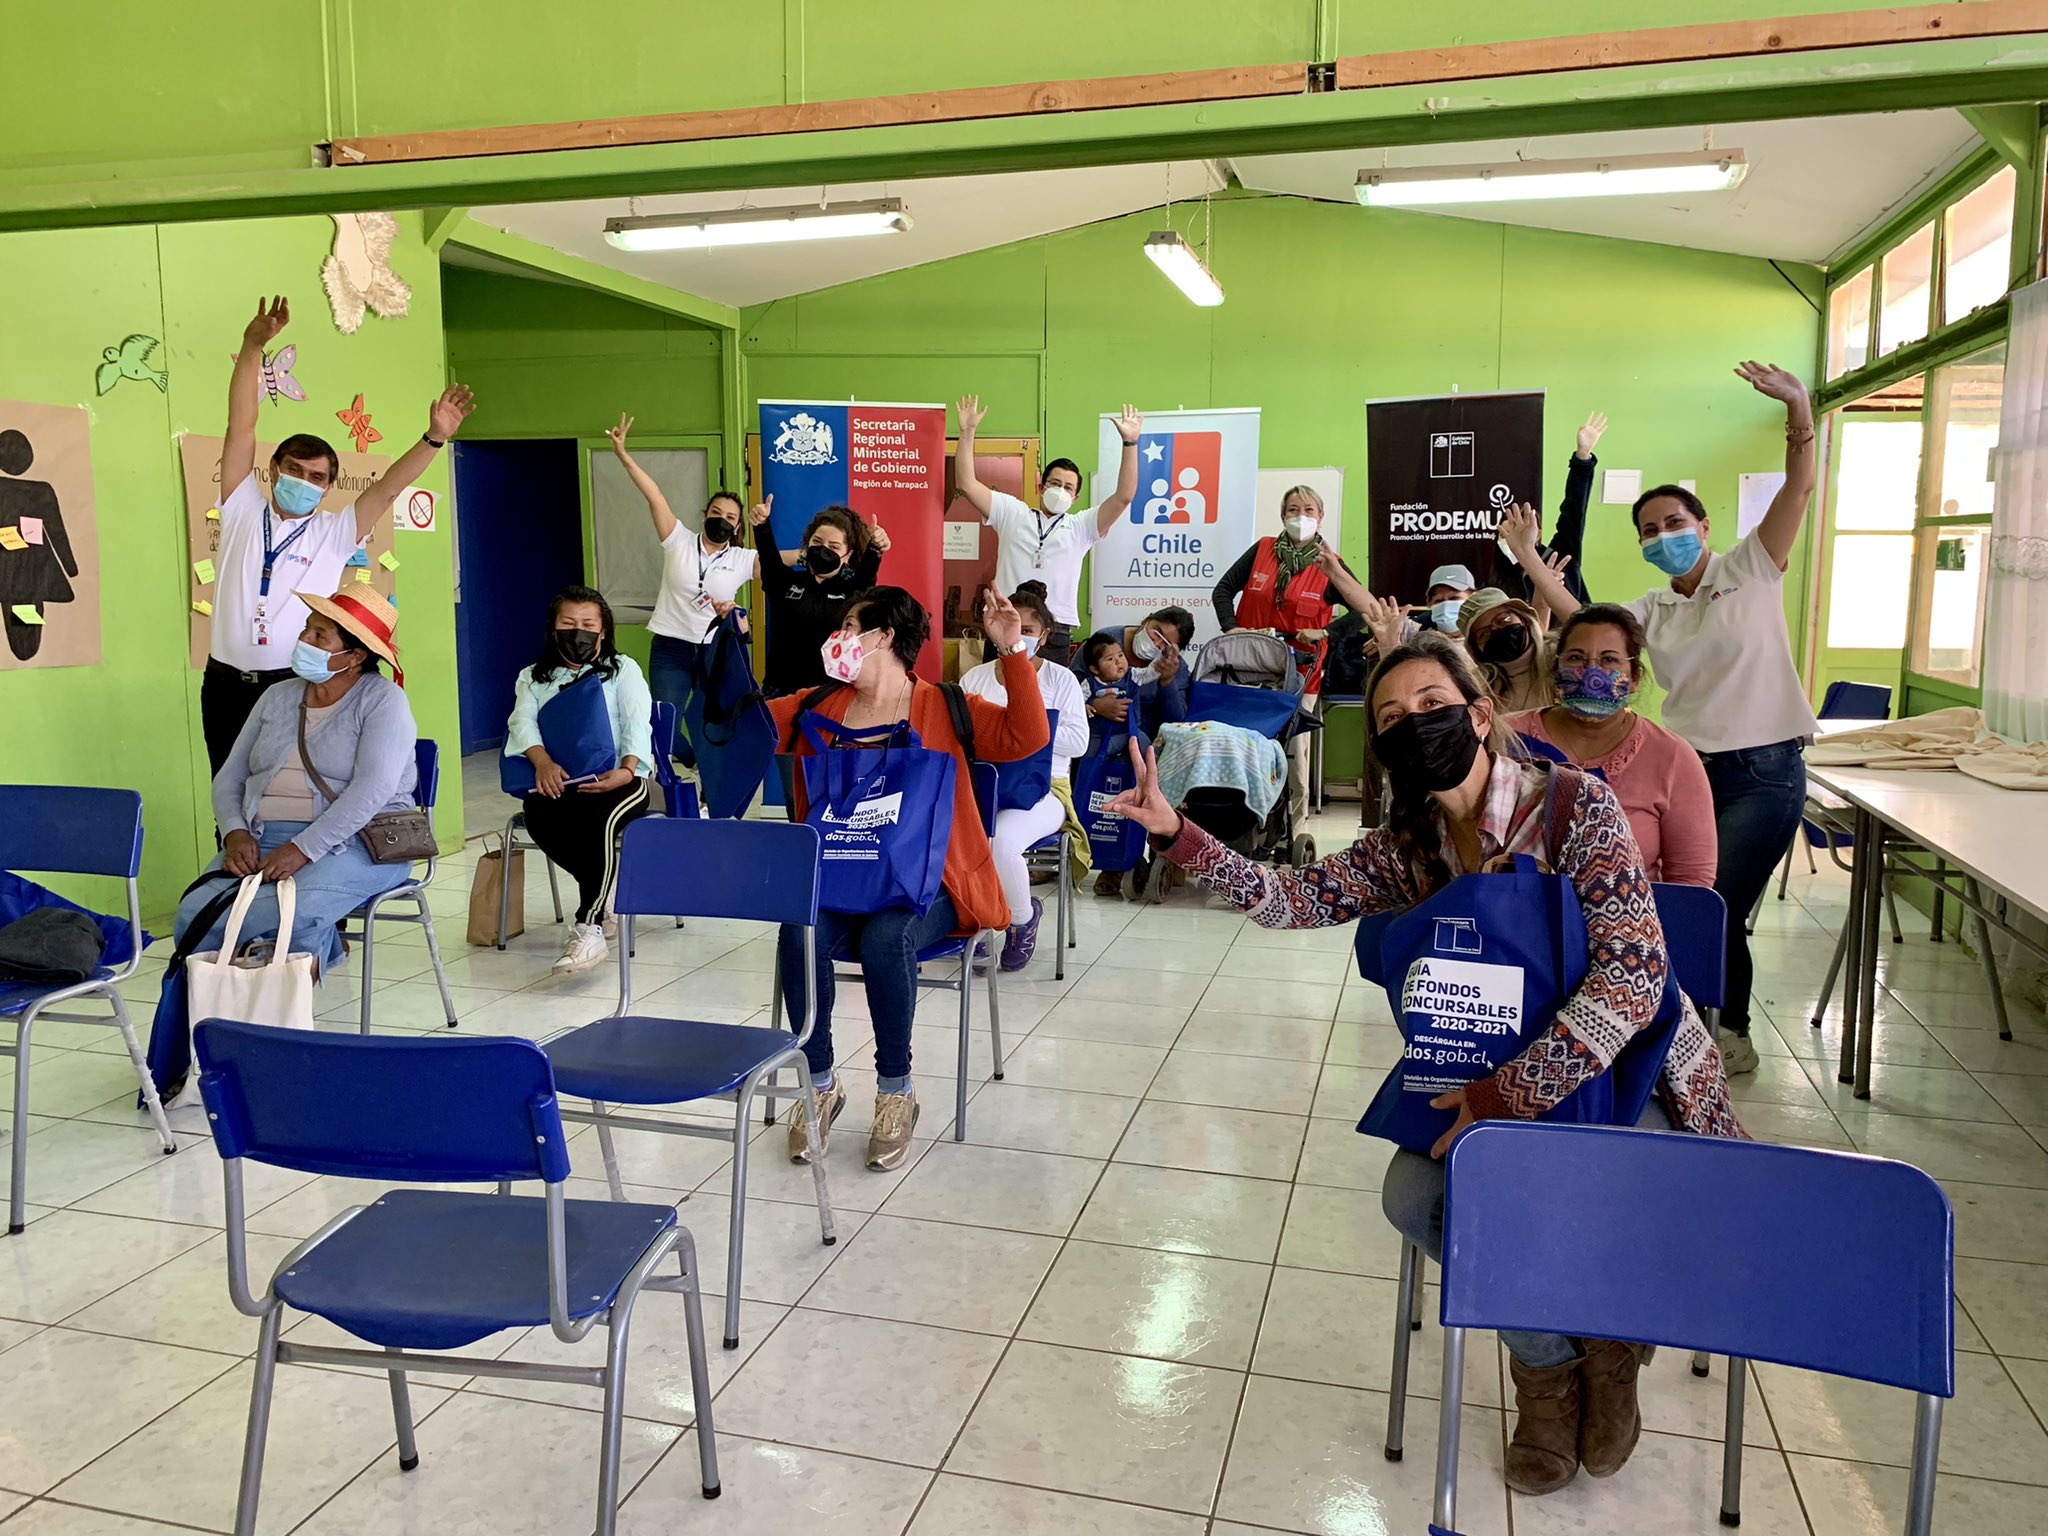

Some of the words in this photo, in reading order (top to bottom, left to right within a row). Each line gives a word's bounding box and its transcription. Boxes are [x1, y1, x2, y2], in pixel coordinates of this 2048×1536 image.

[853, 418, 915, 431] Secretaría
[853, 432, 906, 447] Regional
[853, 447, 920, 460] Ministerial
[853, 461, 868, 473] de
[871, 461, 927, 474] Gobierno
[853, 479, 880, 489] Región
[882, 480, 892, 488] de
[893, 480, 928, 490] Tarapacá
[1389, 502, 1428, 511] Fundación
[1389, 510, 1502, 533] PRODEMU
[1142, 533, 1202, 554] Chile
[1390, 533, 1424, 541] Promoción
[1430, 532, 1465, 540] Desarrollo
[1482, 532, 1497, 541] Muj
[1127, 557, 1214, 578] Atiende
[1106, 594, 1158, 607] Personas
[1161, 597, 1168, 606] a
[1172, 597, 1184, 606] tu
[1187, 596, 1212, 607] serv
[825, 833, 876, 843] dos.gob.cl
[1416, 979, 1481, 998] FONDOS
[1402, 995, 1517, 1019] CONCURSABLES
[1430, 1016, 1507, 1035] 2020-2021
[1414, 1034, 1462, 1048] DESCÁRGALA
[1404, 1043, 1486, 1065] dos.gob.cl
